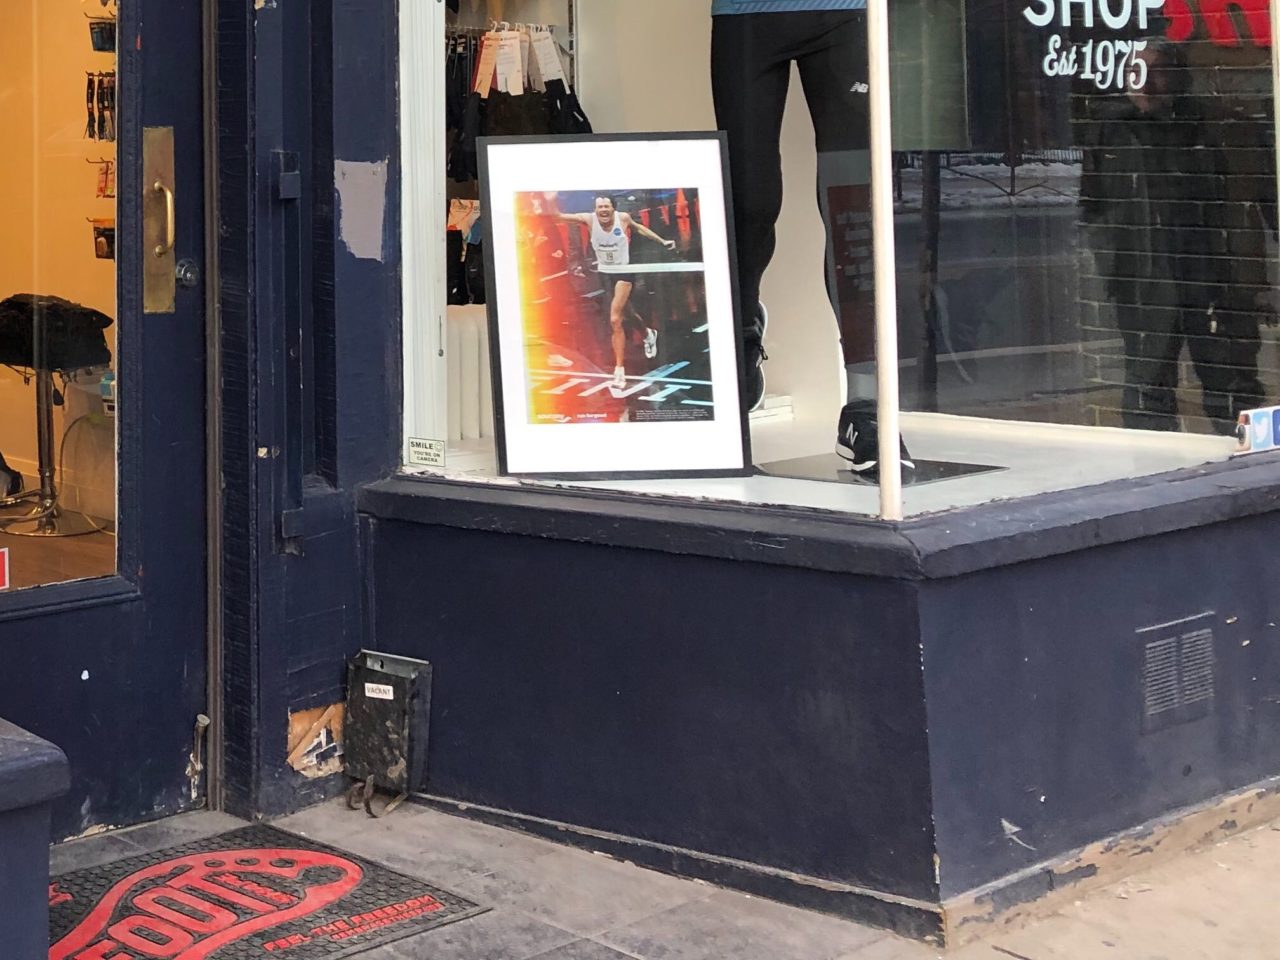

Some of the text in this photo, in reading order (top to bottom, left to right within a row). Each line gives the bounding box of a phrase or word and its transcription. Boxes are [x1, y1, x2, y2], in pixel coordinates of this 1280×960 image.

[1044, 34, 1147, 90] Est 1975
[410, 441, 433, 449] SMILE
